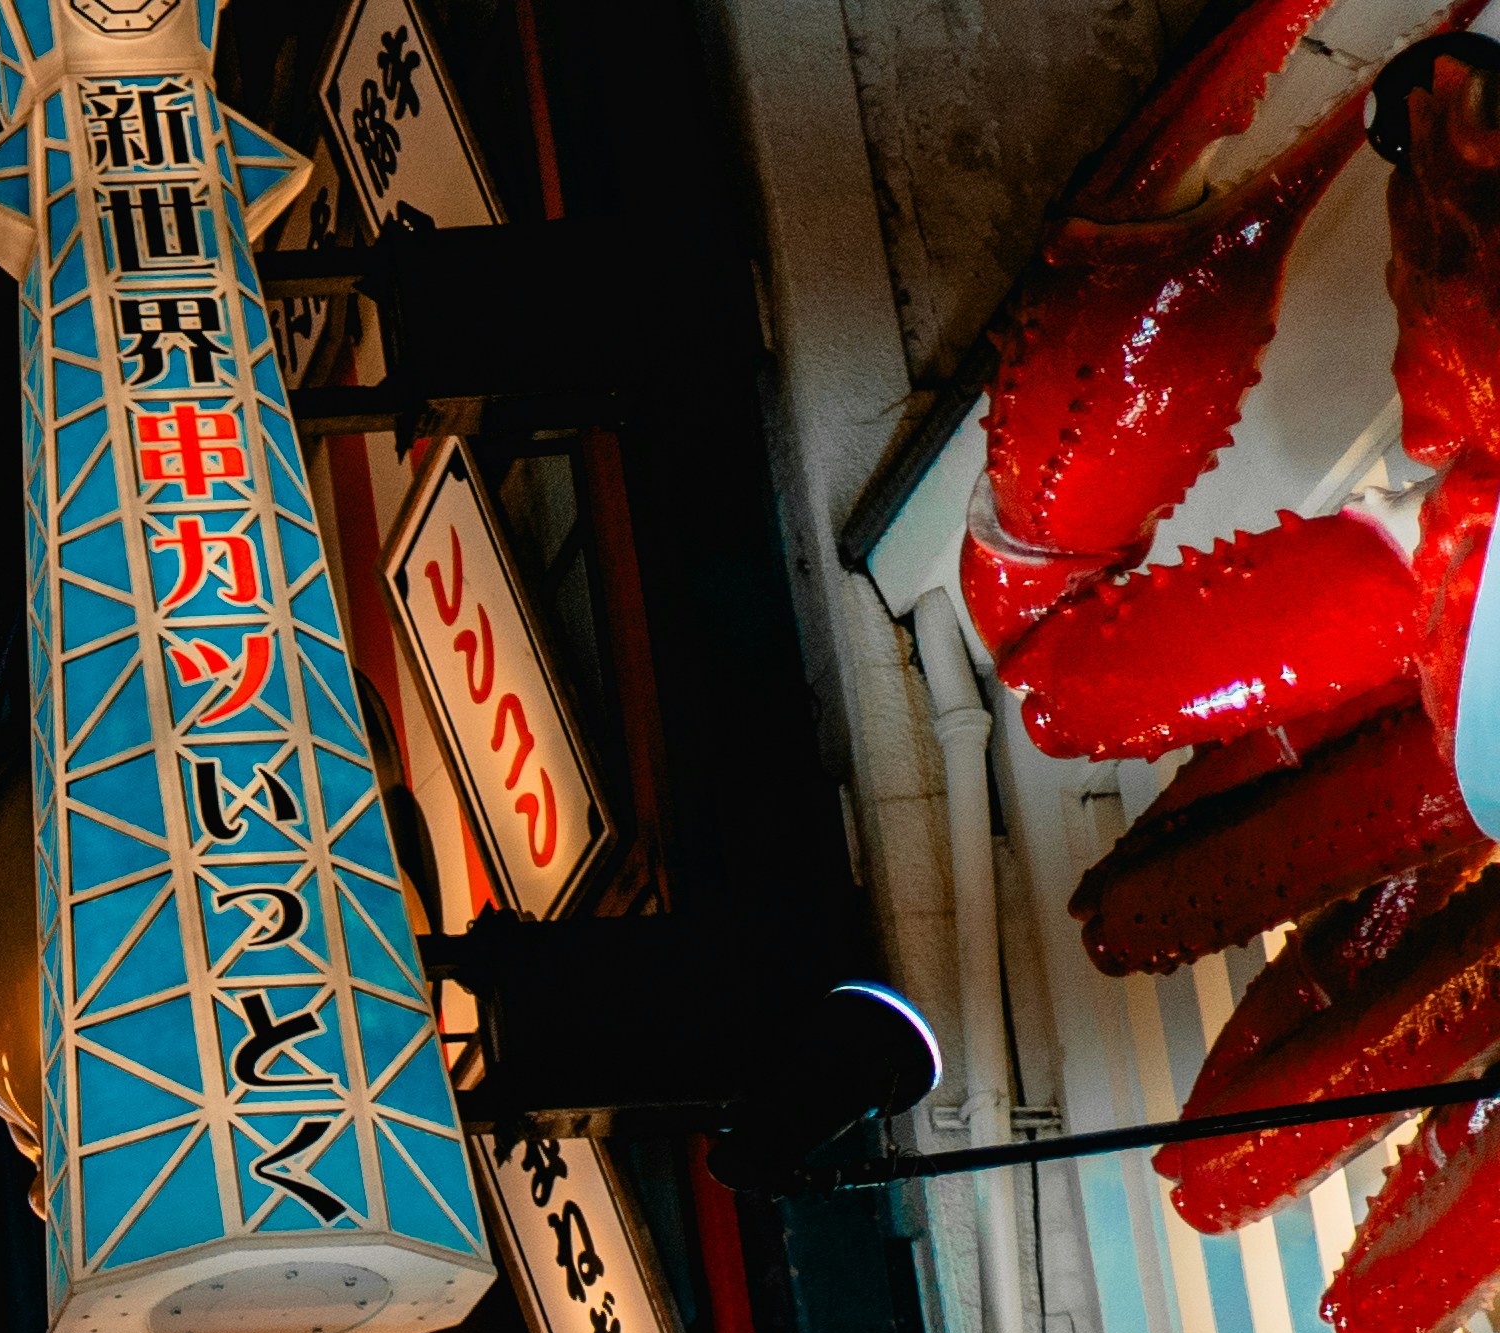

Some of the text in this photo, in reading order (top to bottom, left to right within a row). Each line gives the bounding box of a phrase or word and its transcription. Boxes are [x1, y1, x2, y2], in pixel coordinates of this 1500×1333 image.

[80, 82, 347, 1224] 新世界串カツいっとく
